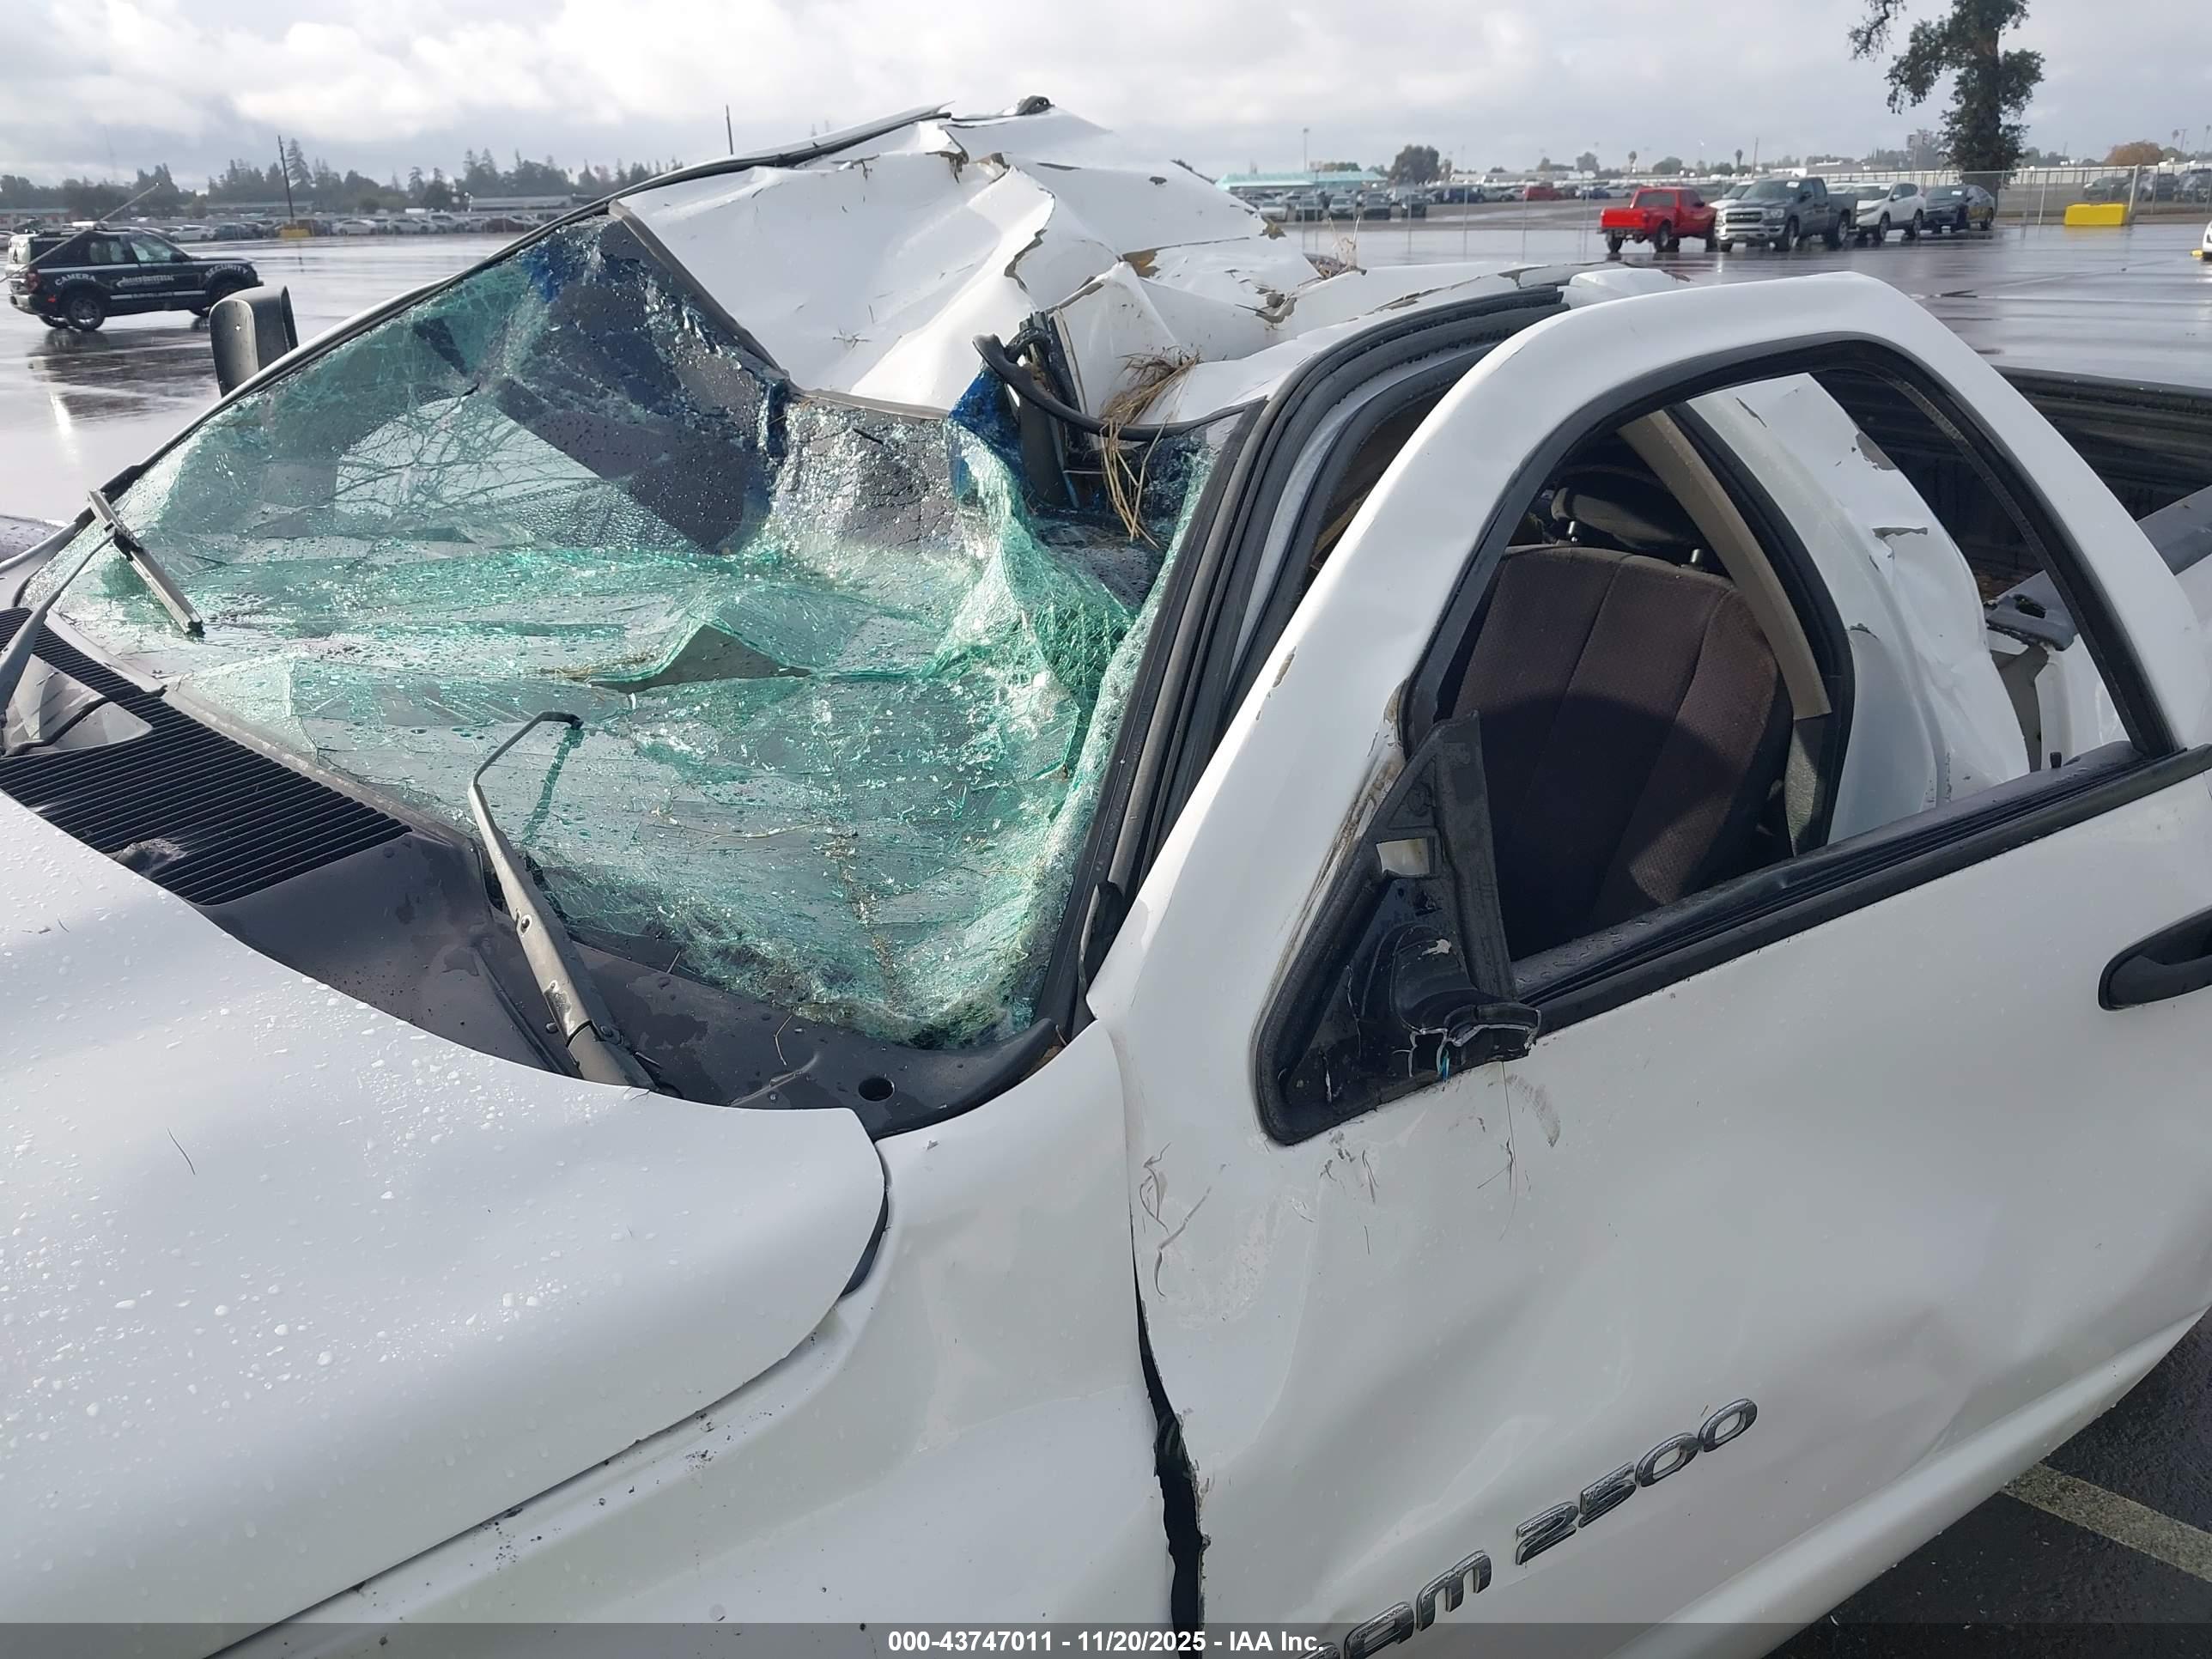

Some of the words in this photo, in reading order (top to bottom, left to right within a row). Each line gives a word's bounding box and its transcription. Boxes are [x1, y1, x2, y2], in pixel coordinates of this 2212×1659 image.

[205, 264, 248, 278] SECURITY
[54, 273, 97, 286] CAMERA
[1515, 1397, 1759, 1565] 2500
